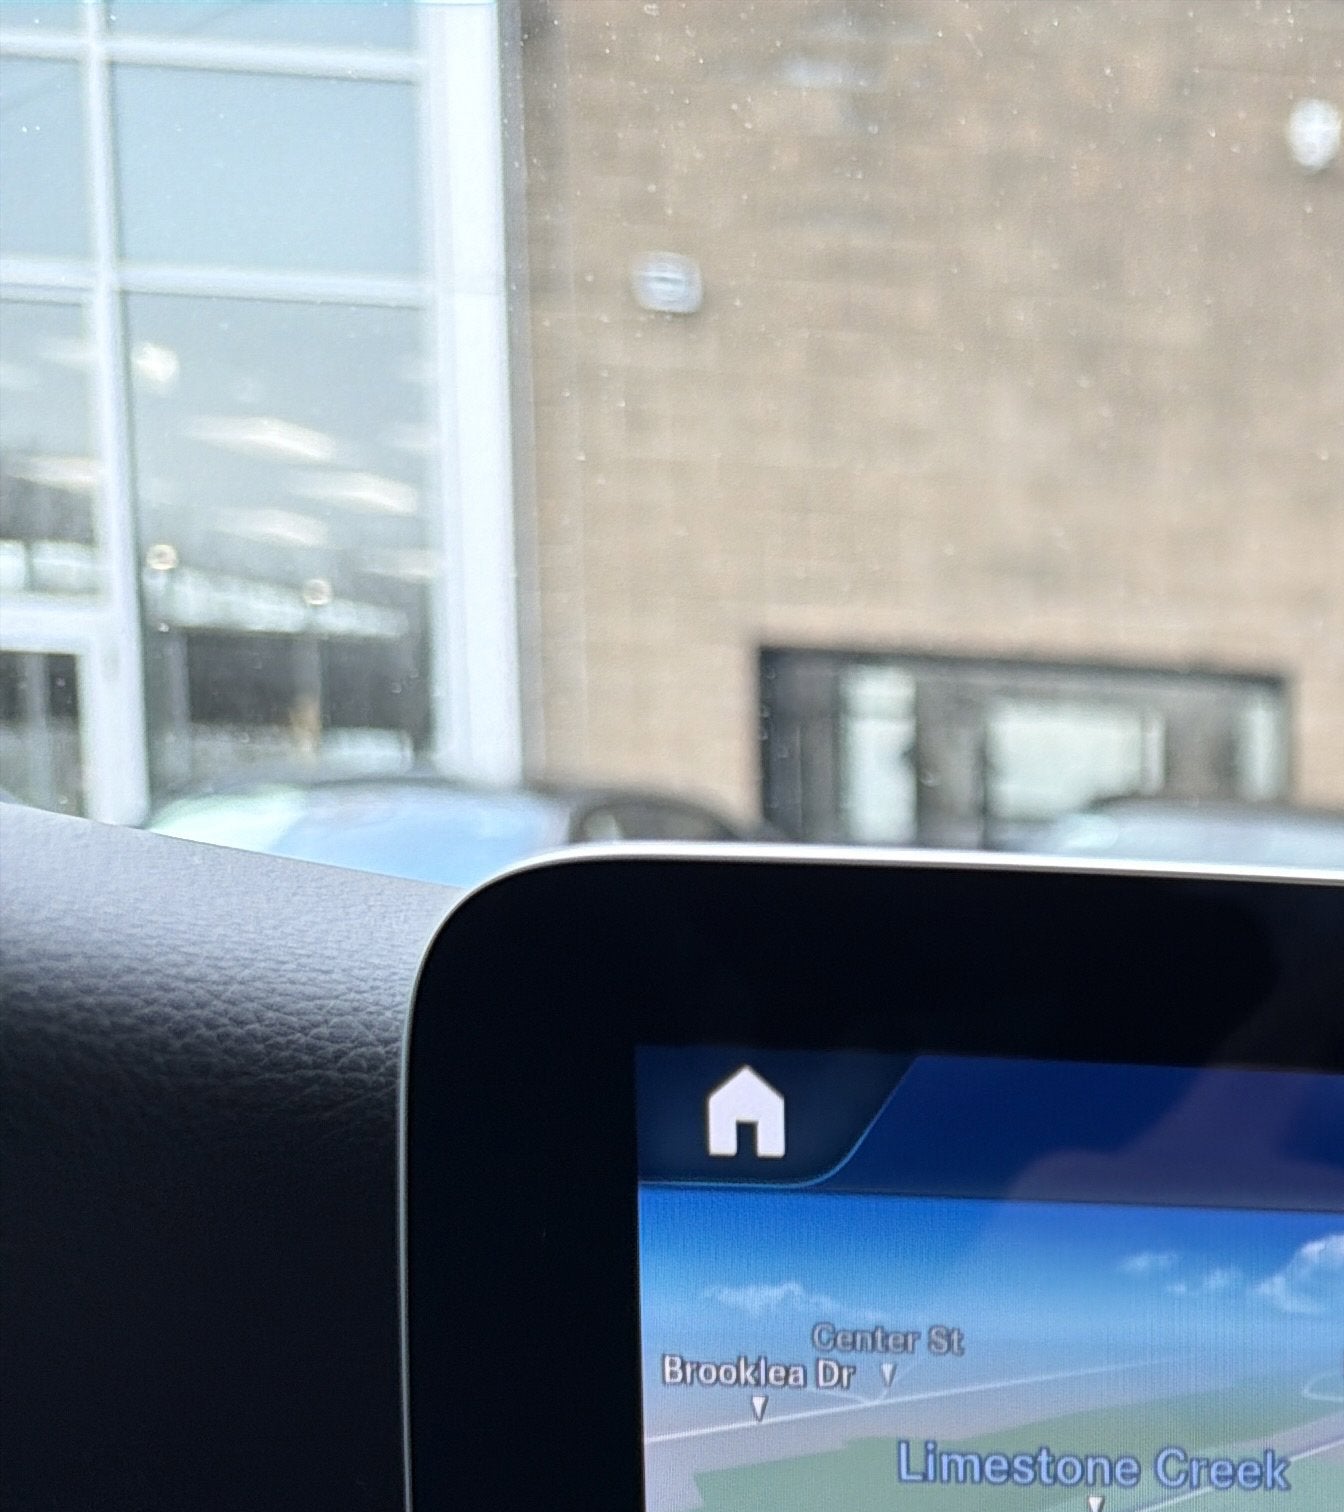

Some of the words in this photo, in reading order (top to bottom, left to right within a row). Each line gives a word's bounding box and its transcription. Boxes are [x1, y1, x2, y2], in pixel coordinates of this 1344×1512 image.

[812, 1322, 920, 1355] Center
[928, 1327, 965, 1358] St
[662, 1354, 806, 1389] Brooklea
[816, 1358, 856, 1391] Dr
[896, 1441, 1140, 1487] Limestone
[1154, 1448, 1291, 1492] Creek
